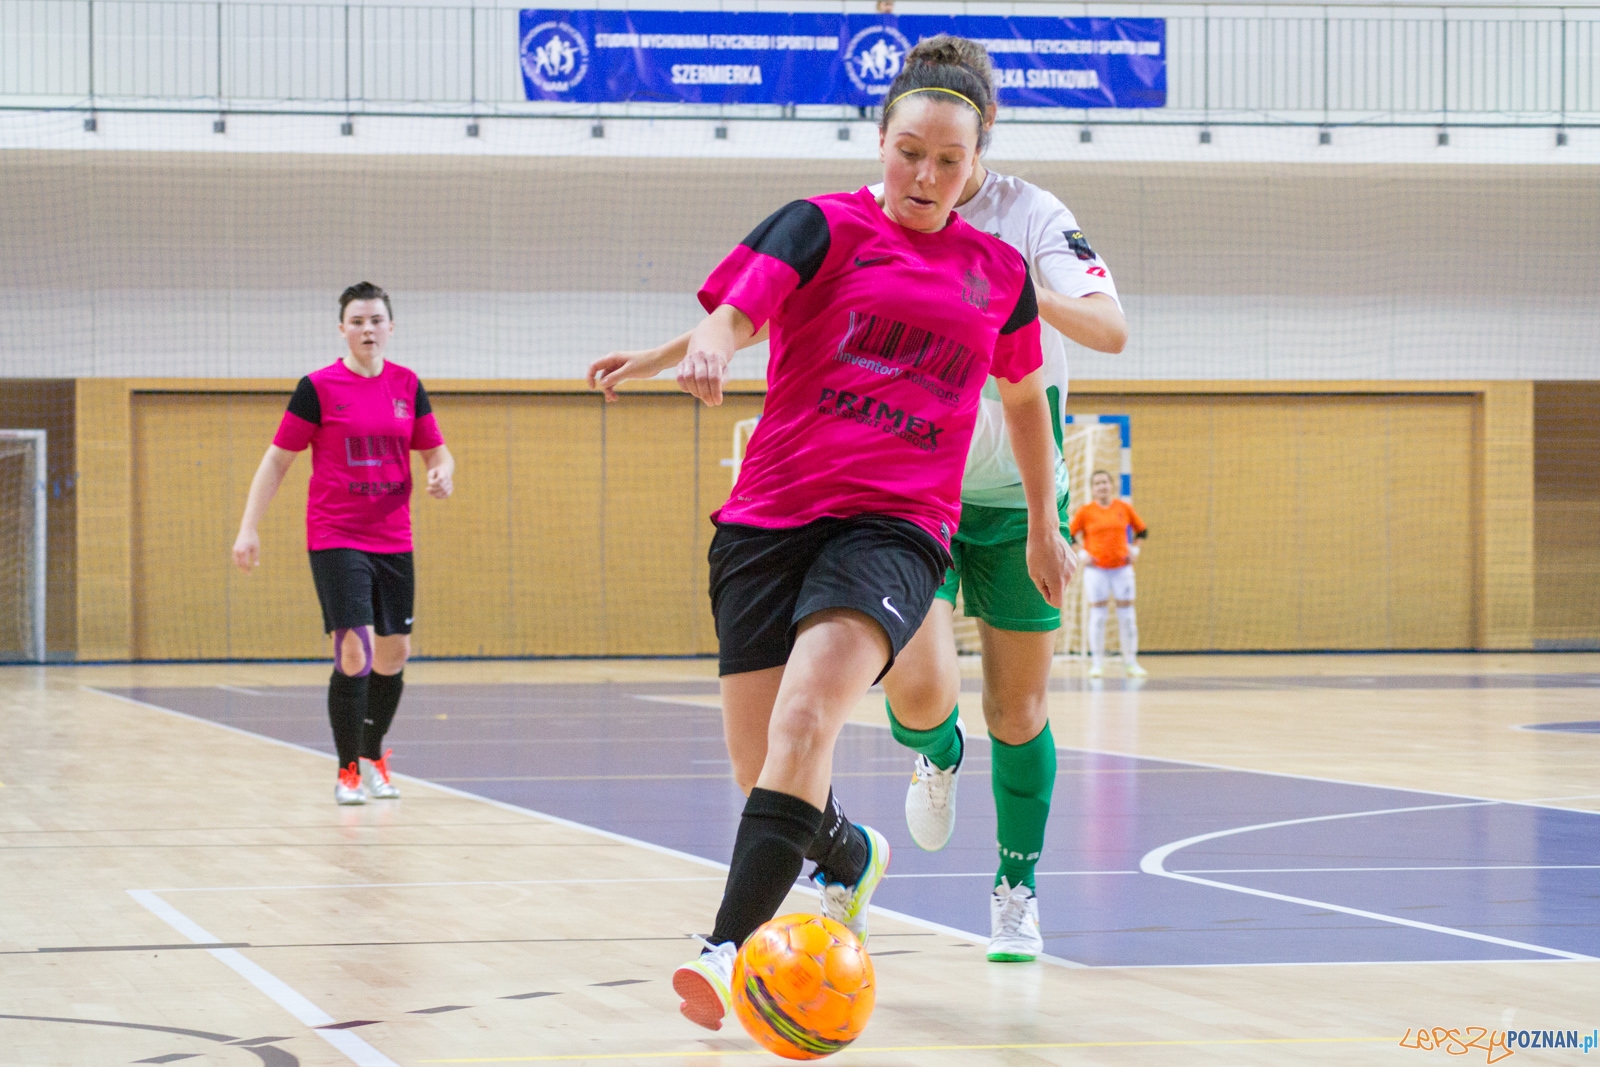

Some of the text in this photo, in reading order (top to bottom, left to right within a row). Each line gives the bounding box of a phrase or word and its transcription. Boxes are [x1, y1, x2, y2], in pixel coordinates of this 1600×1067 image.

[671, 64, 762, 85] SZERMIERKA
[1026, 69, 1099, 89] SIATKOWA
[834, 349, 961, 401] inventory solutions
[817, 387, 944, 446] PRIMEX
[882, 423, 938, 453] OSOBOWY
